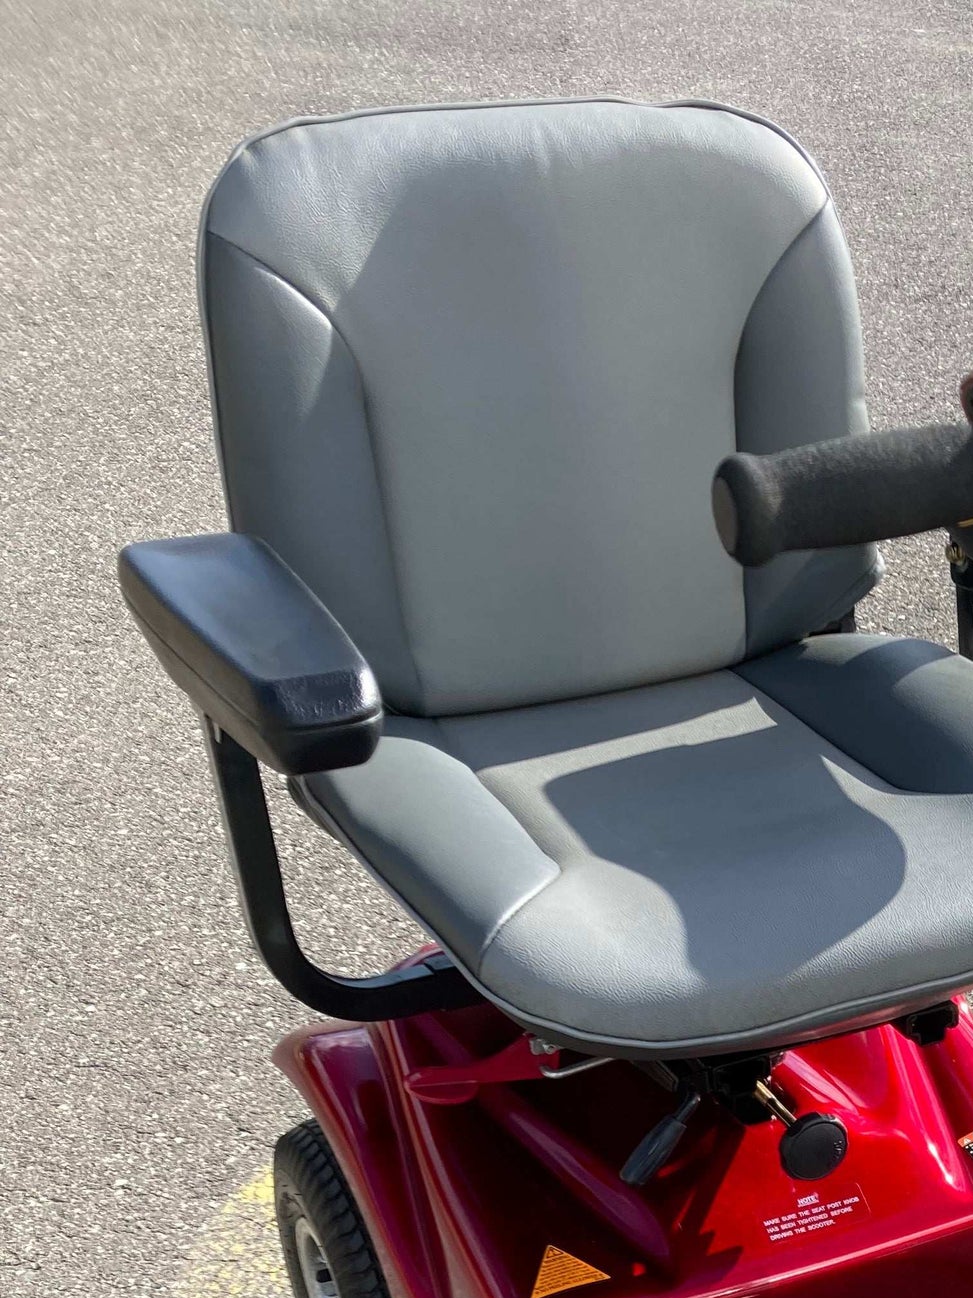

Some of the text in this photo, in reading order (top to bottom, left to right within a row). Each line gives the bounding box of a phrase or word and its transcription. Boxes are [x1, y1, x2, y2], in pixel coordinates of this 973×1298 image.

[763, 1217, 781, 1226] MAKE
[781, 1213, 798, 1222] SURE
[798, 1209, 810, 1218] THE
[811, 1205, 826, 1214] SEAT
[827, 1201, 842, 1210] POST
[766, 1206, 853, 1234] HAS BEEN TIGHTENED BEFORE
[769, 1230, 794, 1241] DRIVING
[794, 1226, 807, 1234] THE
